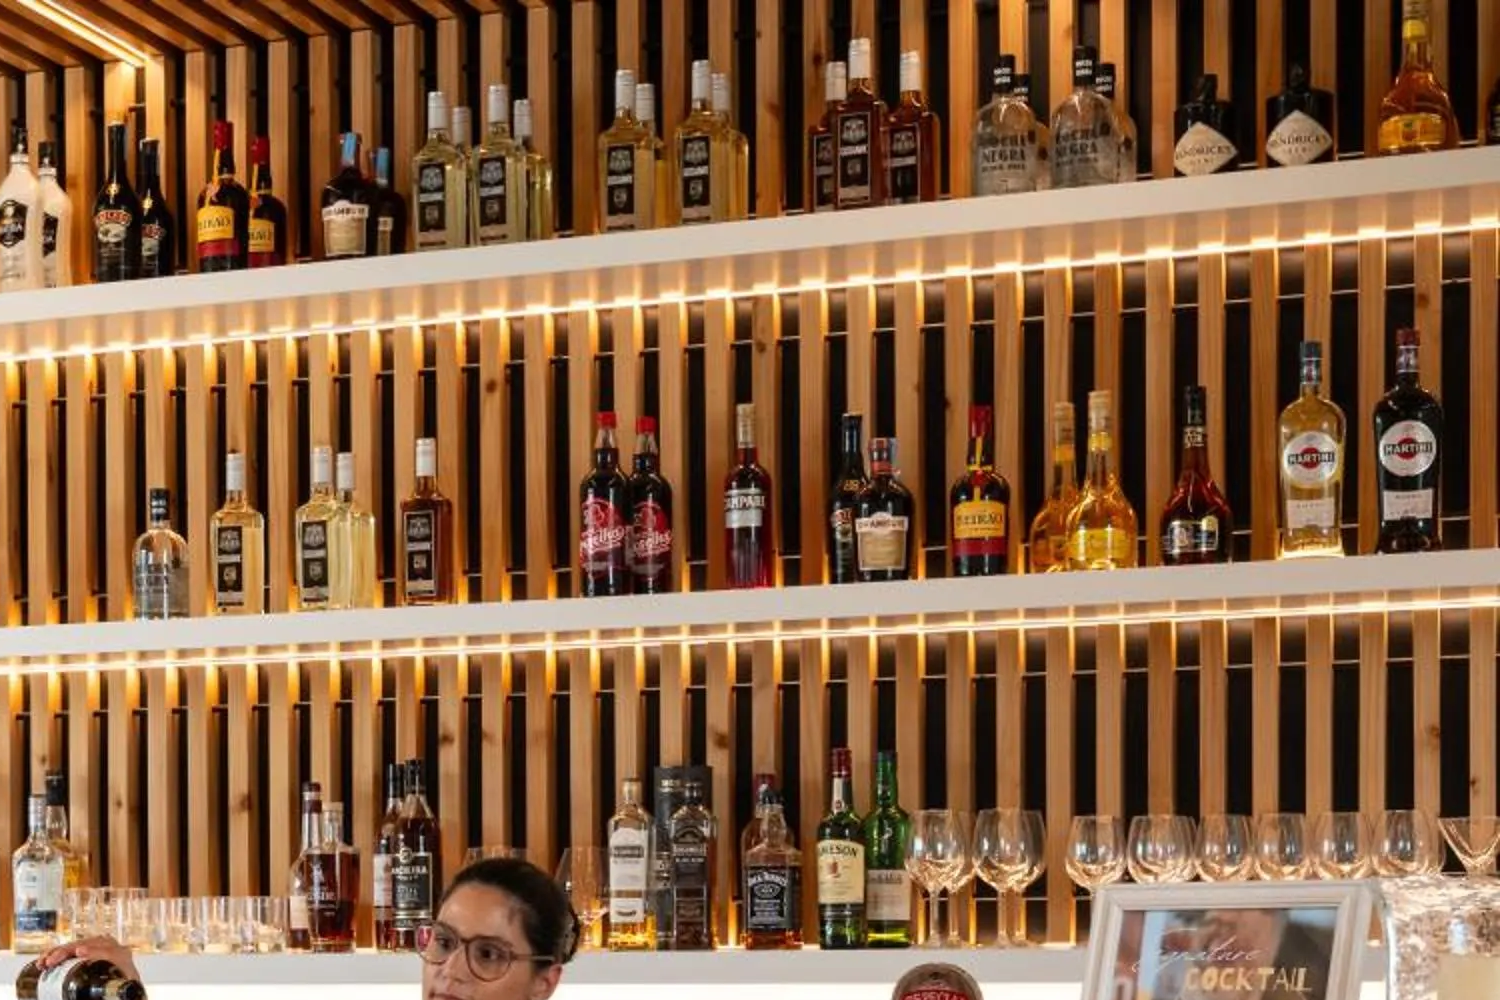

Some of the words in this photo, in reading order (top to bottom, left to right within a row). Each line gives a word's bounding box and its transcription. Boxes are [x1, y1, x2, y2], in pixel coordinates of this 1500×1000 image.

[982, 147, 1026, 163] NEGRA
[1384, 441, 1433, 456] MARTINI
[1288, 451, 1335, 466] MARTINI
[1185, 966, 1313, 992] COCKTAIL
